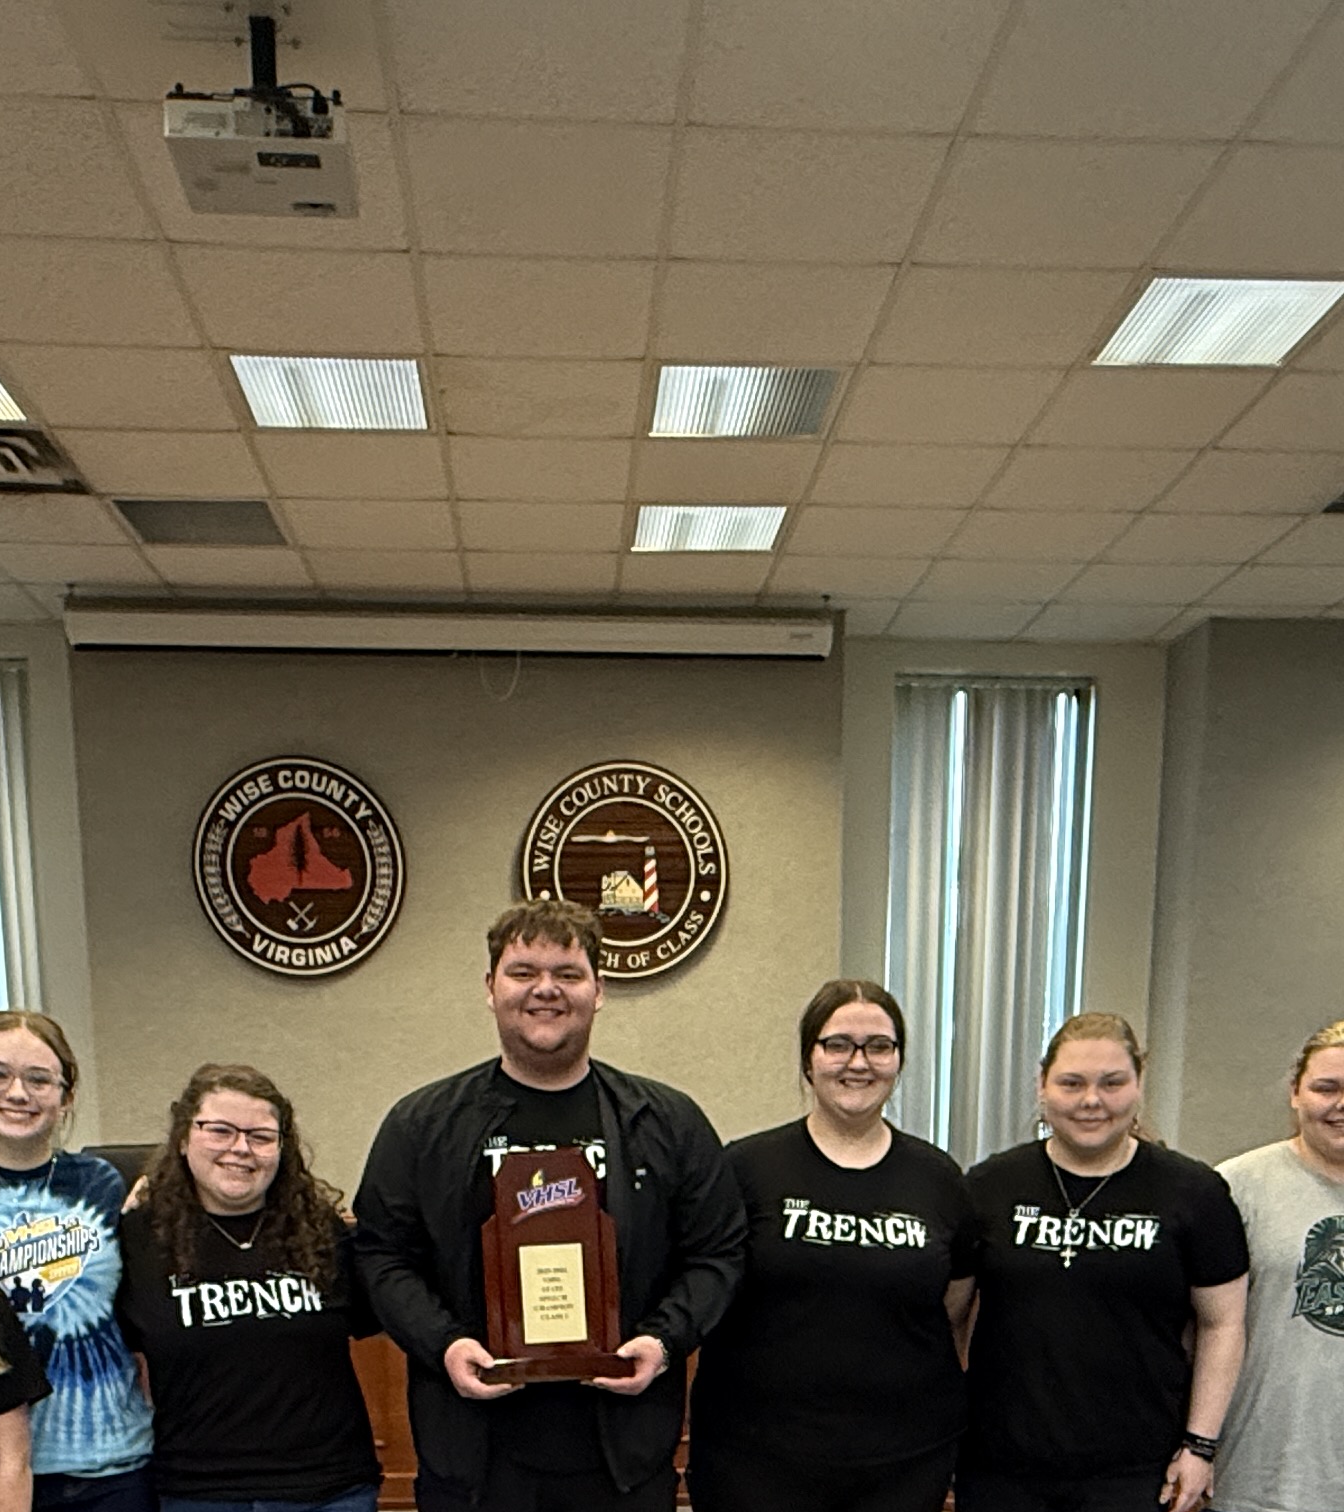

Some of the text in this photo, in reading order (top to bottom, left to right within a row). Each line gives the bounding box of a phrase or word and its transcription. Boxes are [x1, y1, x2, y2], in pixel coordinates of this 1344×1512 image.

[219, 770, 373, 822] WISE COUNTY
[533, 774, 716, 876] WISE COUNTY SCHOOLS
[252, 932, 358, 967] VIRGINIA
[626, 950, 651, 969] OF
[657, 910, 704, 960] CLASS
[517, 1177, 582, 1211] VHSL
[783, 1198, 810, 1209] THE
[1014, 1204, 1041, 1216] THE
[782, 1208, 927, 1249] TRENCH
[1013, 1214, 1160, 1250] TRENCH
[171, 1277, 323, 1328] TRENCH
